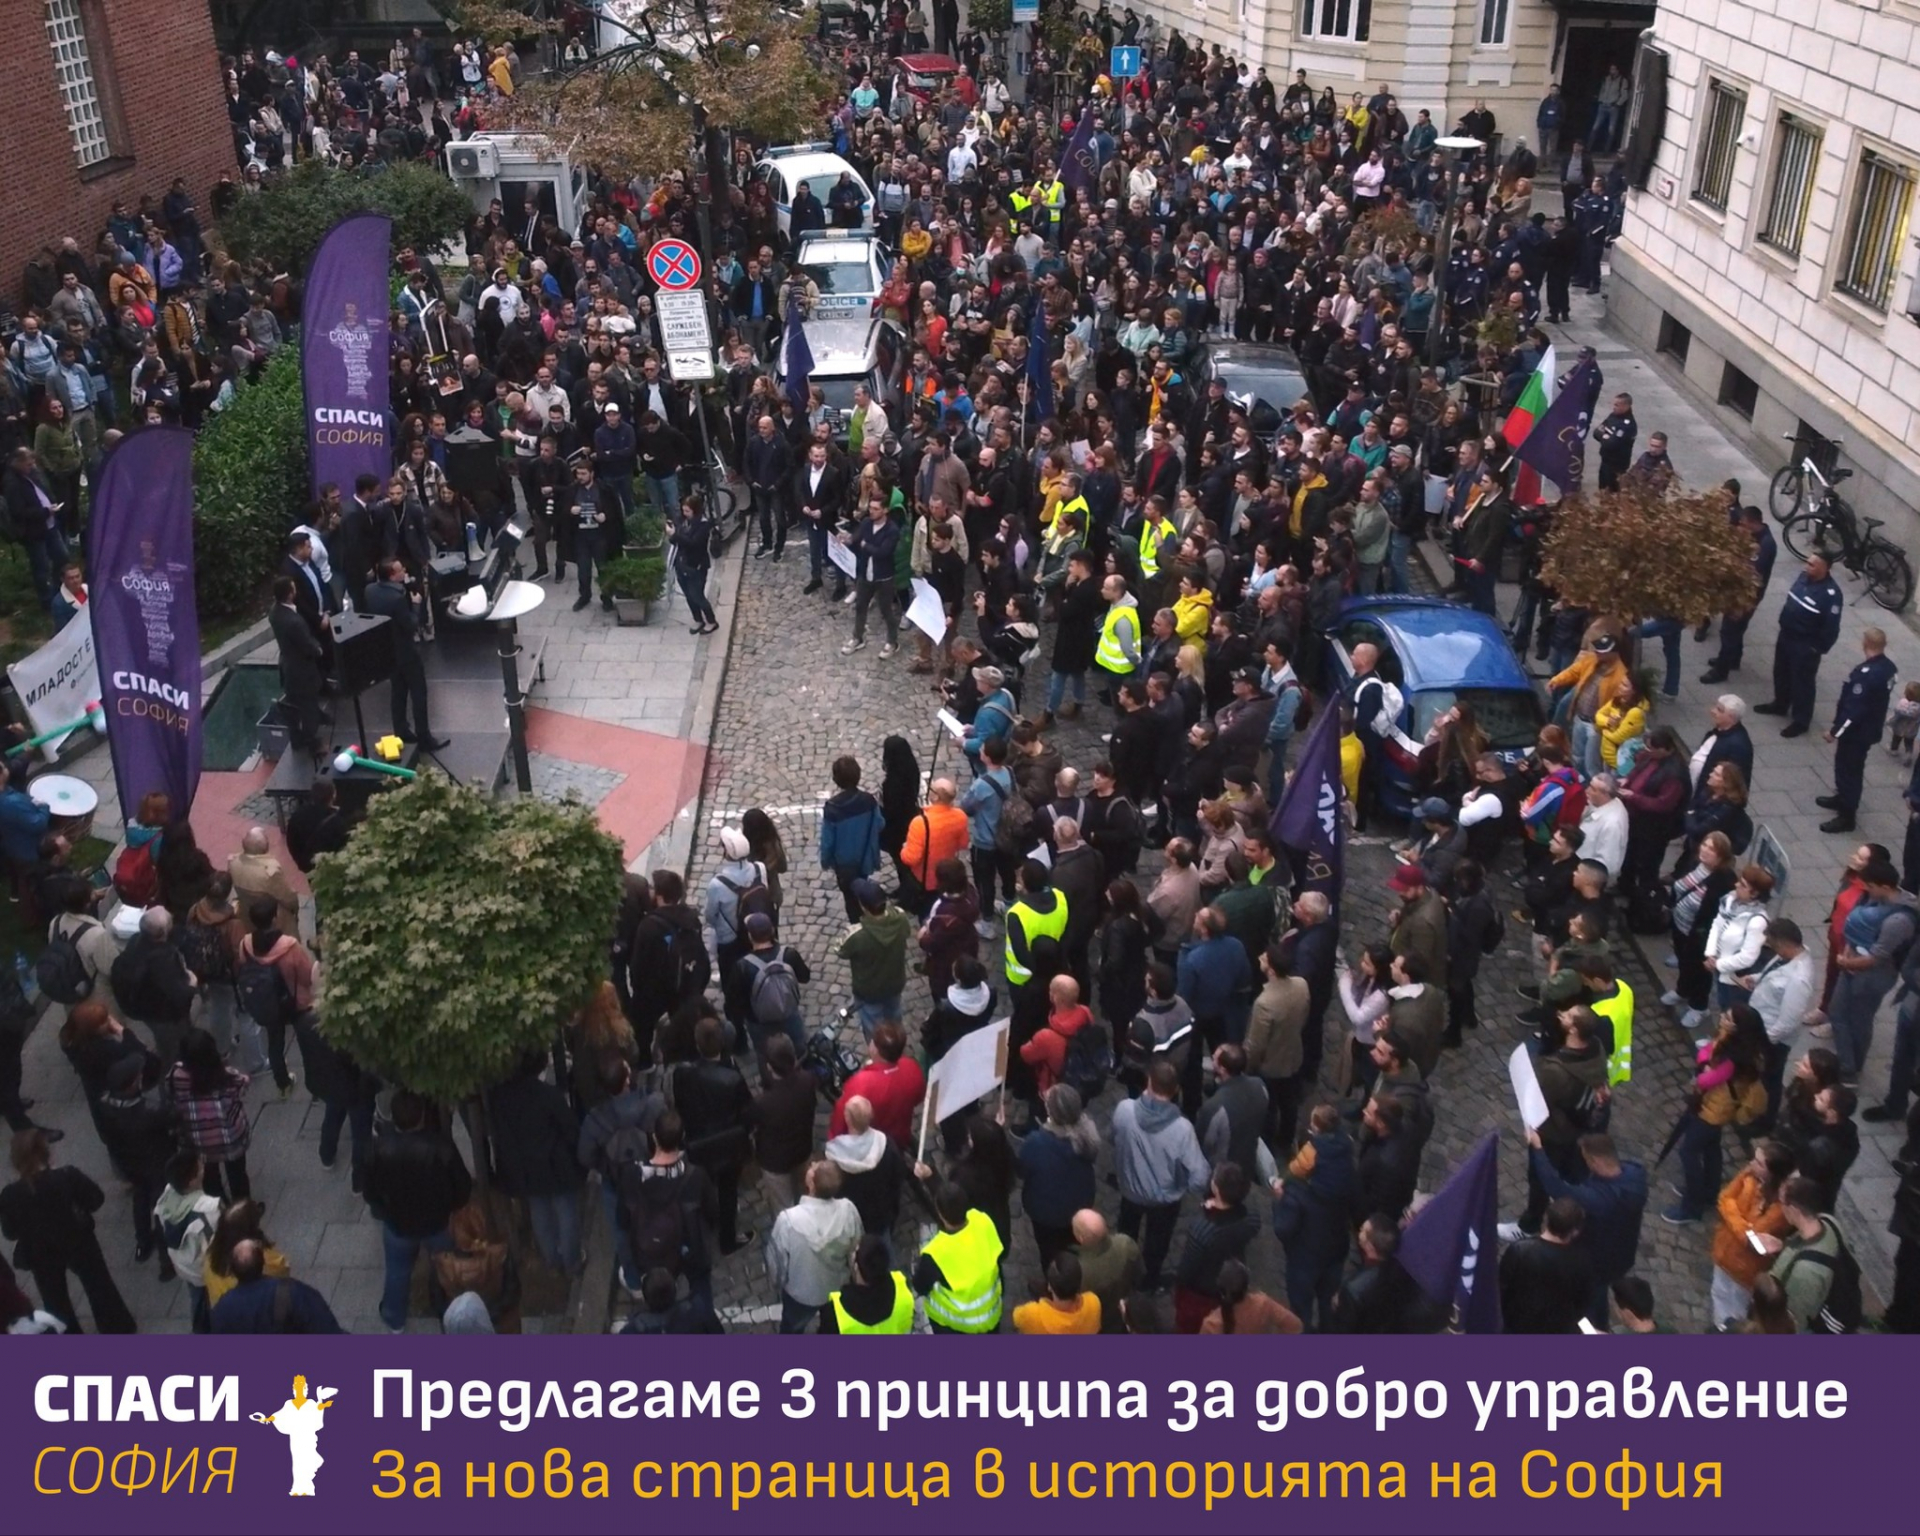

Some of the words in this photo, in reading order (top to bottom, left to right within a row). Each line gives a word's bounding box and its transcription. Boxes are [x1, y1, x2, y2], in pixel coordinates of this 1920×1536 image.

[820, 296, 857, 306] OLICE
[329, 330, 369, 348] София
[315, 407, 383, 428] СПАСИ
[316, 428, 384, 447] СОФИЯ
[122, 576, 171, 597] София
[113, 671, 190, 710] СПАСИ
[117, 697, 190, 737] СОФИЯ
